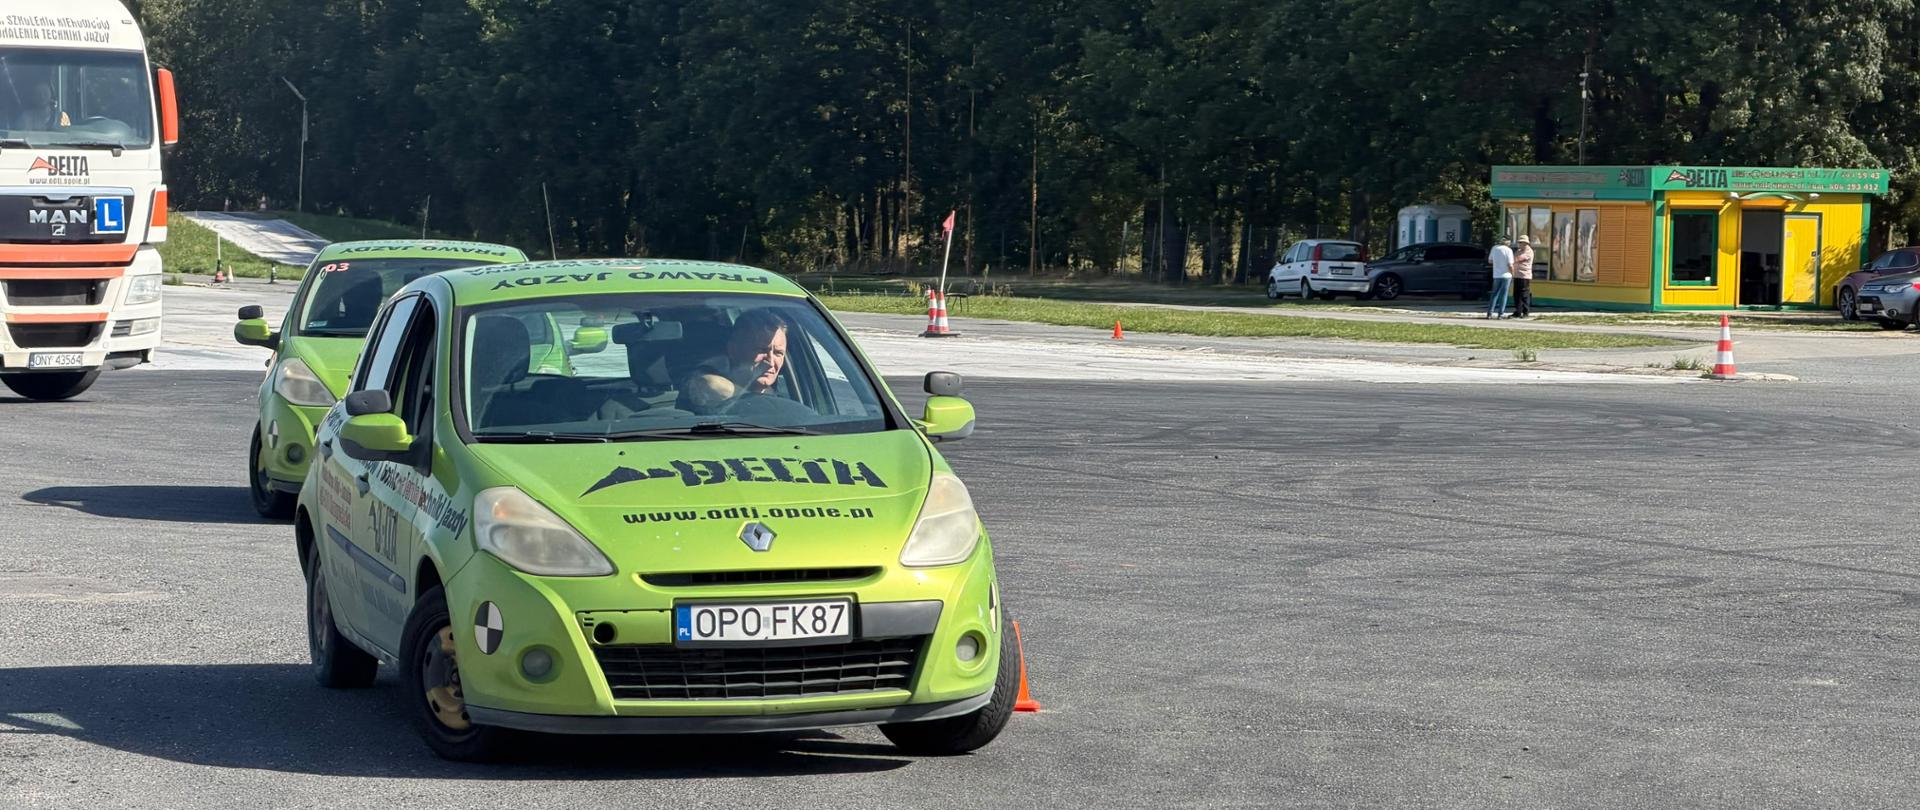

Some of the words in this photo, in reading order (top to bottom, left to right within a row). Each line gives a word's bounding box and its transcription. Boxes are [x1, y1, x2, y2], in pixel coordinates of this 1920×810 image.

[41, 28, 82, 42] TECHNIKI
[47, 155, 89, 176] DELTA
[1685, 168, 1728, 188] DELTA
[29, 209, 87, 224] MAN
[104, 202, 118, 227] L
[339, 245, 413, 255] JAZDY
[421, 246, 507, 257] PRAWO
[325, 262, 350, 272] 03
[490, 271, 613, 291] JAZDY
[628, 271, 769, 284] PRAWO
[669, 457, 889, 488] DELTA
[623, 506, 874, 524] www.odtj.opole.pl
[696, 606, 762, 638] OPO
[772, 604, 845, 636] FK87
[679, 627, 691, 637] PL
